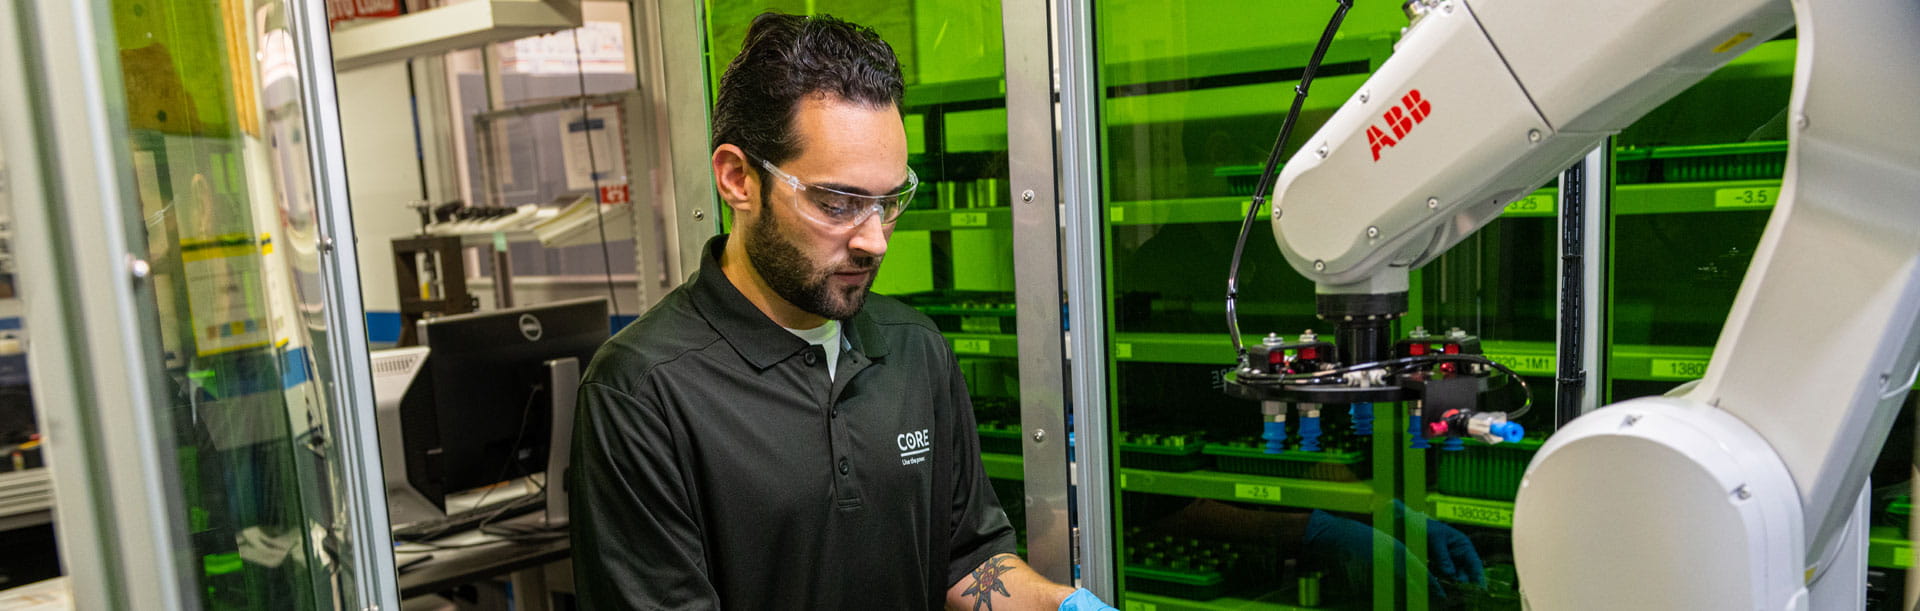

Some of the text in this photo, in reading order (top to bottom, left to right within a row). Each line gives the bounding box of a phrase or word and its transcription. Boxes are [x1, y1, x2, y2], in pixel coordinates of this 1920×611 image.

[1366, 89, 1432, 162] ABB
[1736, 190, 1768, 204] -3.5
[897, 429, 930, 451] CORE
[1248, 486, 1269, 498] -2.5
